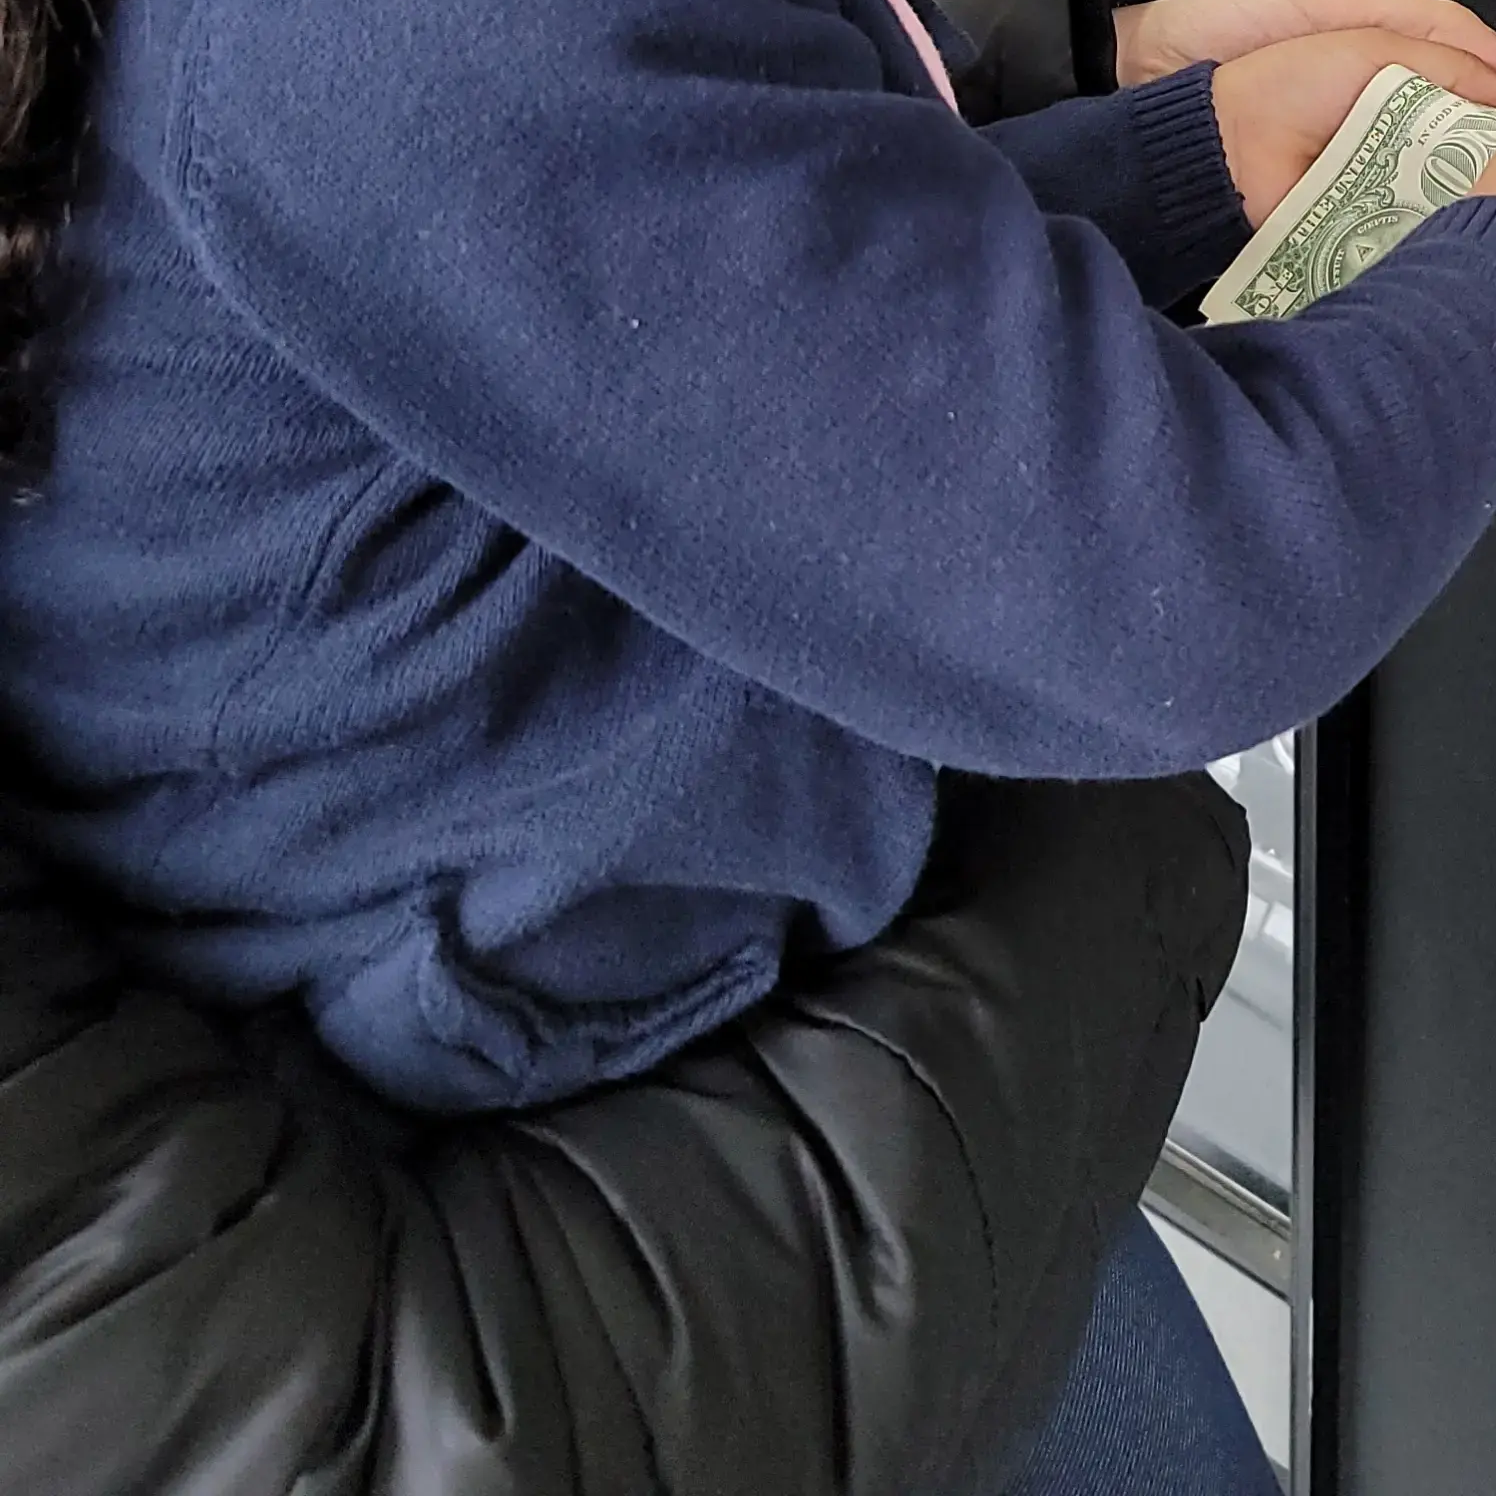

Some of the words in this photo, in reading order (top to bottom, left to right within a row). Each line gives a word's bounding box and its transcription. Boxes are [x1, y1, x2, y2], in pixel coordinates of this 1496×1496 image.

[1417, 132, 1430, 147] IN
[1428, 106, 1453, 130] GOD
[1288, 198, 1335, 249] THE
[1332, 112, 1393, 201] UNITED
